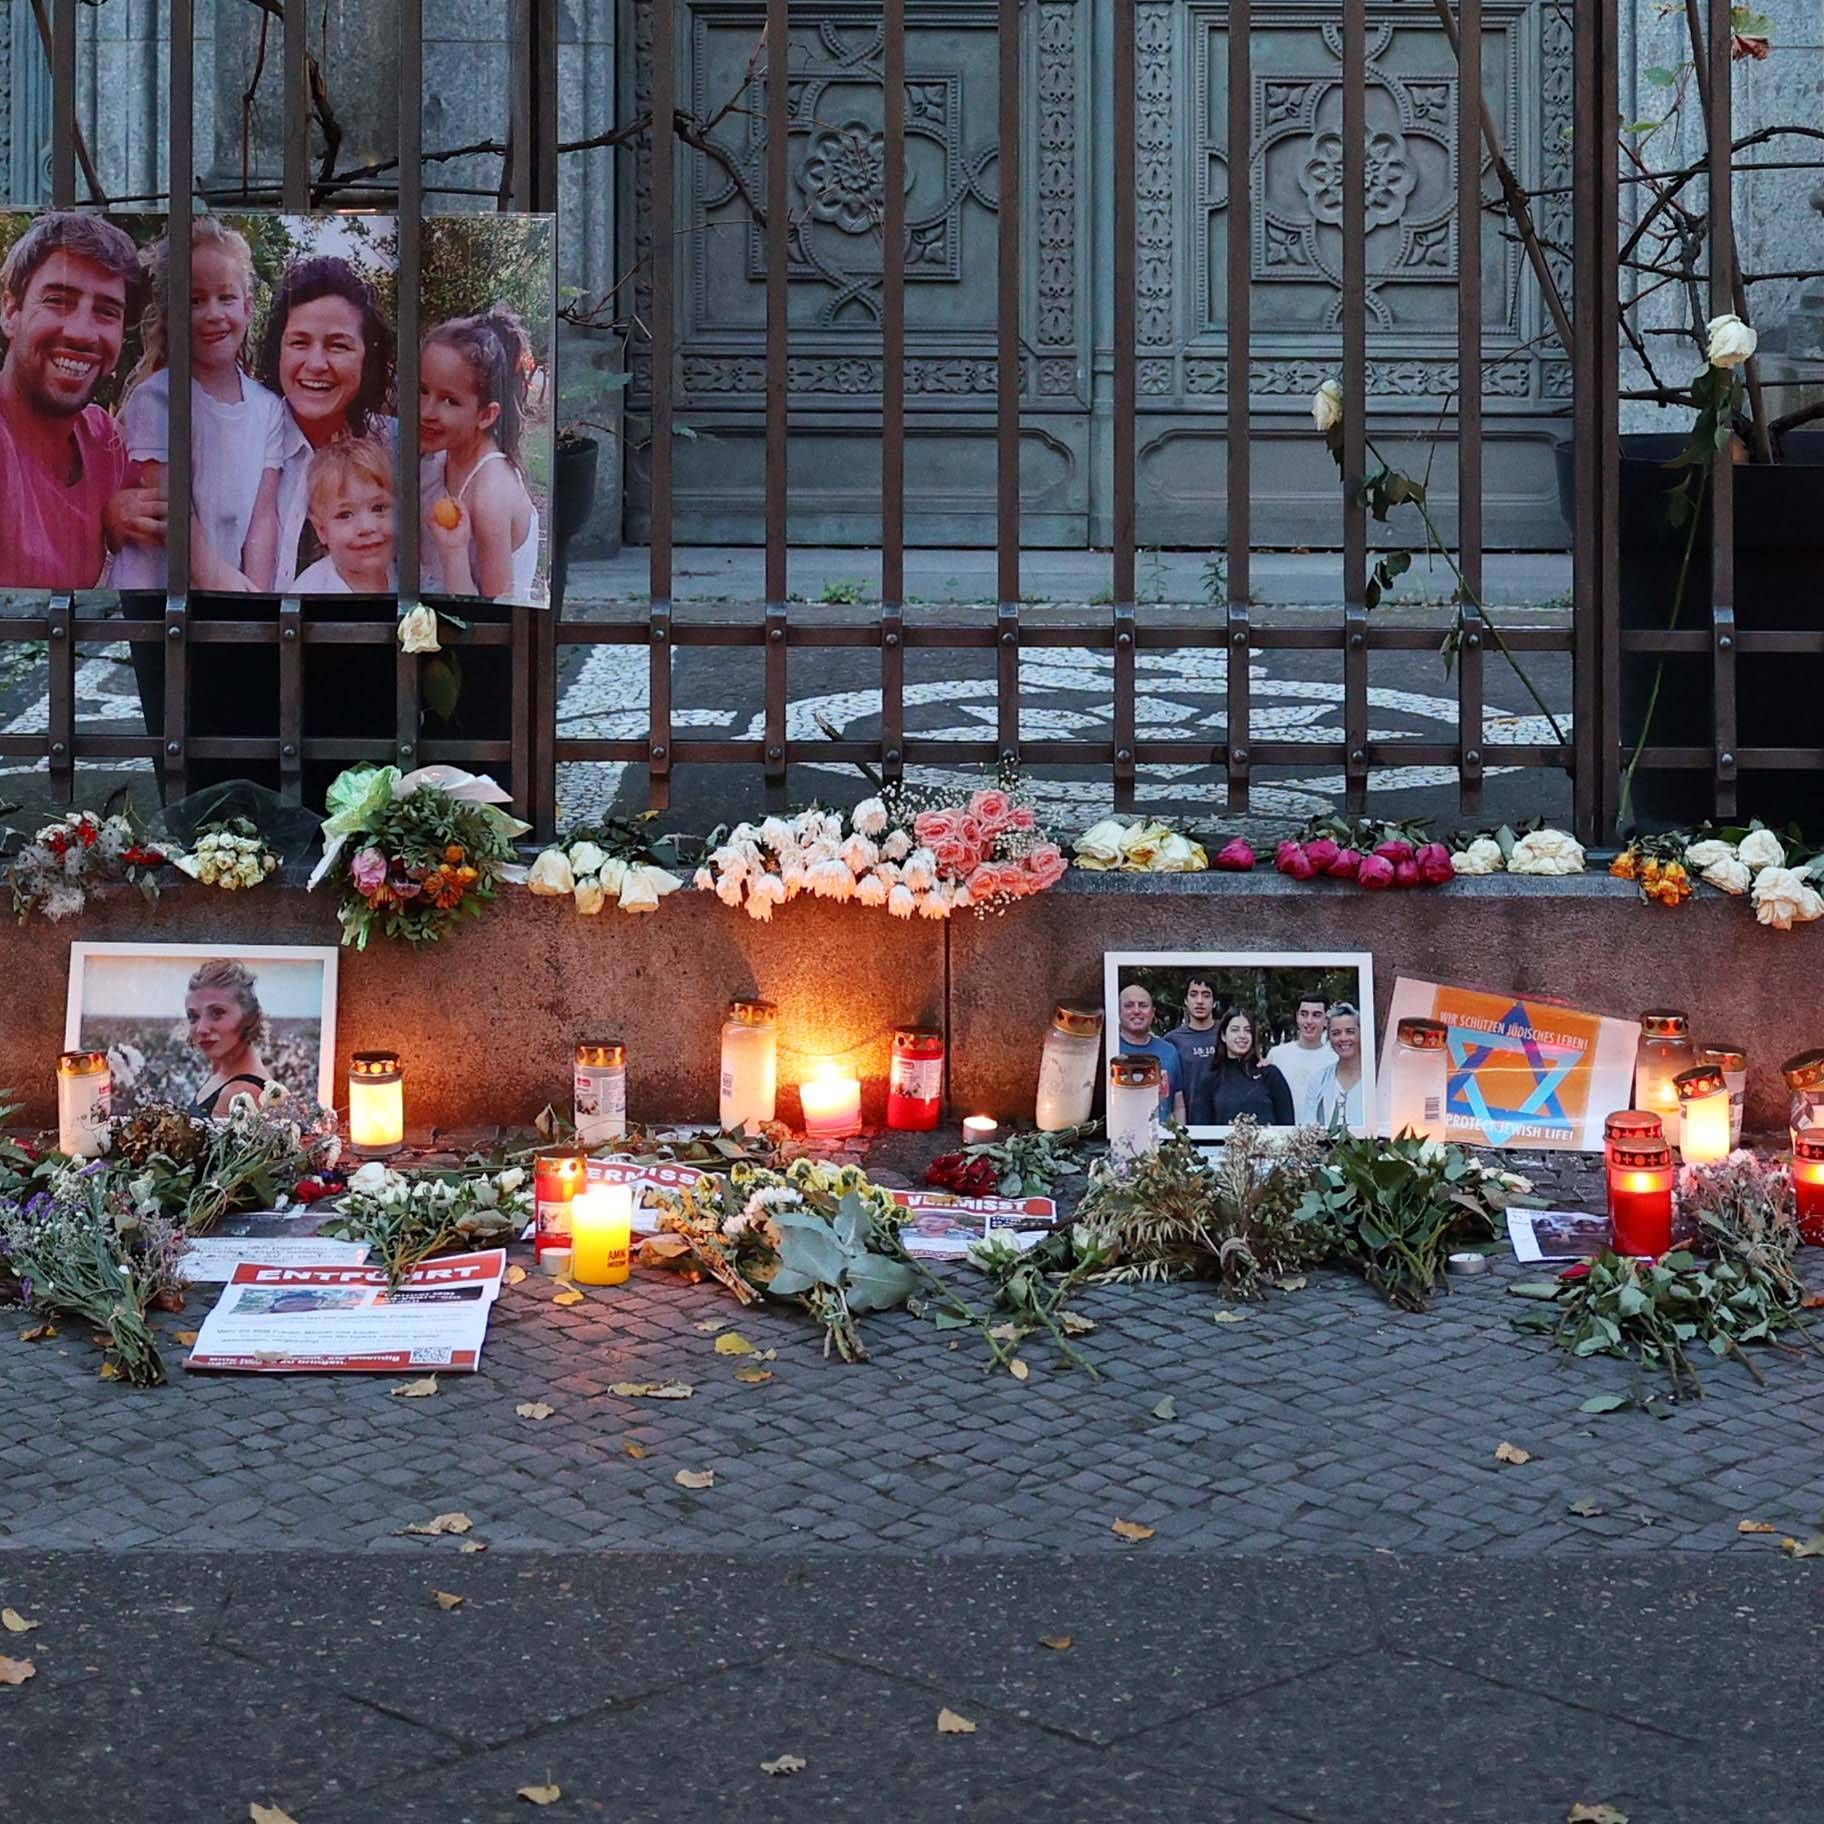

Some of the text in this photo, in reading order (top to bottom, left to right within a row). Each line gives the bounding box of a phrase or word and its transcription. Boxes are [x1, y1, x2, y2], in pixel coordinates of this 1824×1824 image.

[1440, 1011, 1589, 1049] WIR SCHÜTZEN JÜDISCHES LEBEN!
[1497, 1120, 1541, 1138] JEWISH
[1544, 1128, 1574, 1141] LIFE!
[587, 1167, 696, 1185] ERMISS
